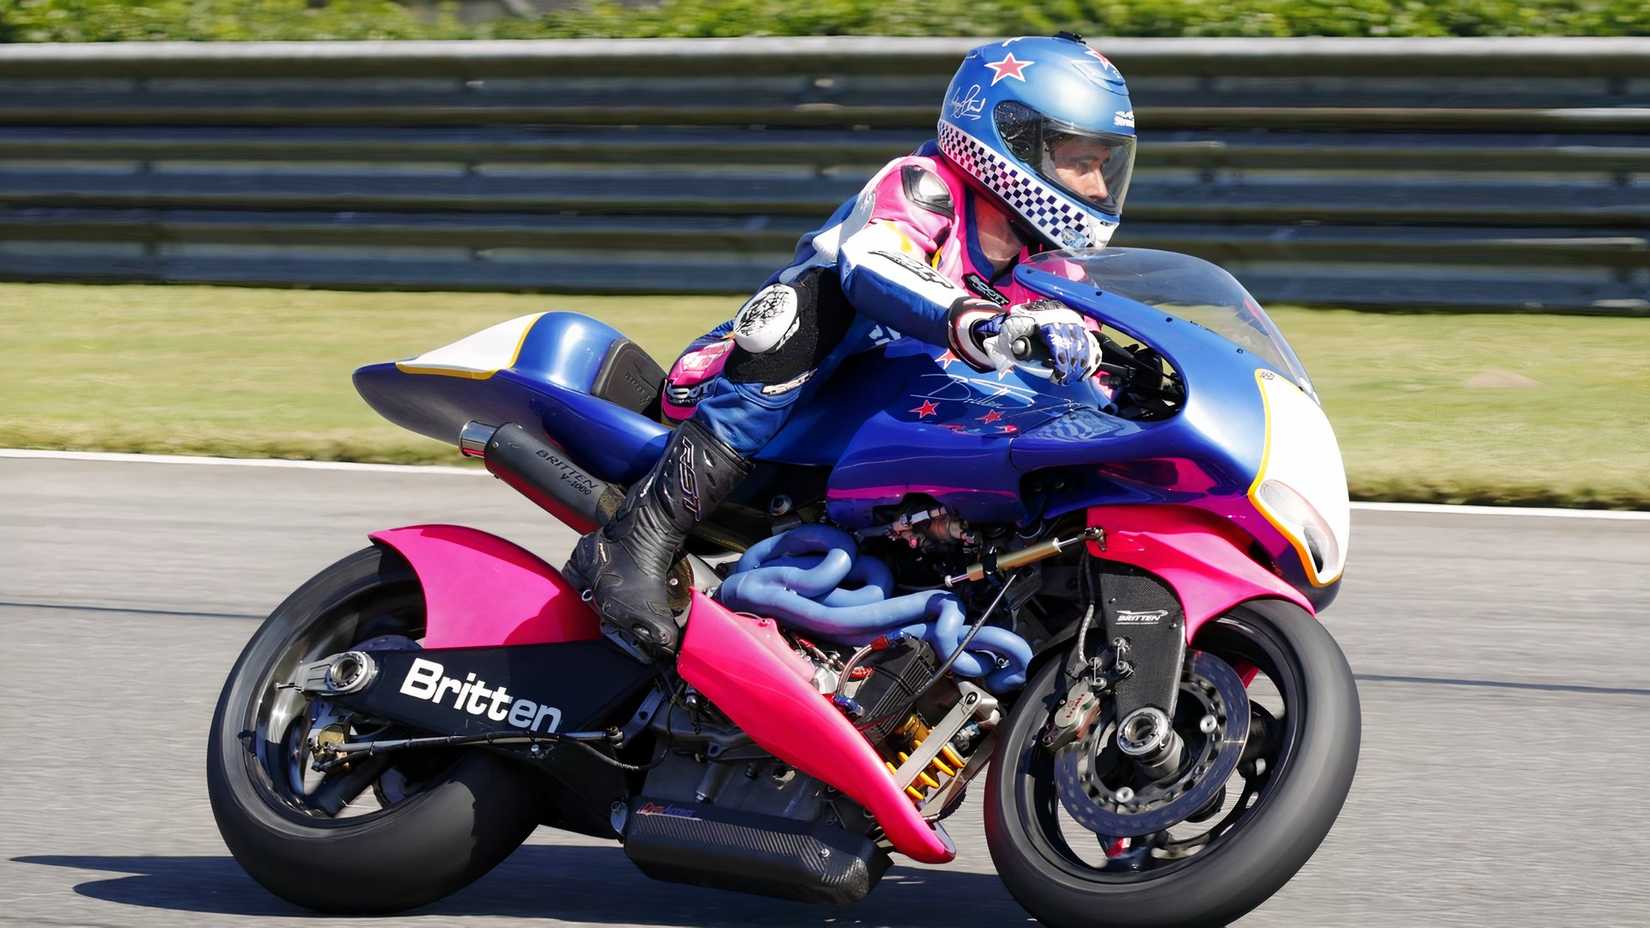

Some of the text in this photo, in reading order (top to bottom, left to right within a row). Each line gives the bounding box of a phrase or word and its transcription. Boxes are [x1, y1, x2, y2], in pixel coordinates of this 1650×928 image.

[535, 448, 600, 490] BRITTEN
[679, 435, 702, 522] RST
[399, 657, 563, 734] Britten
